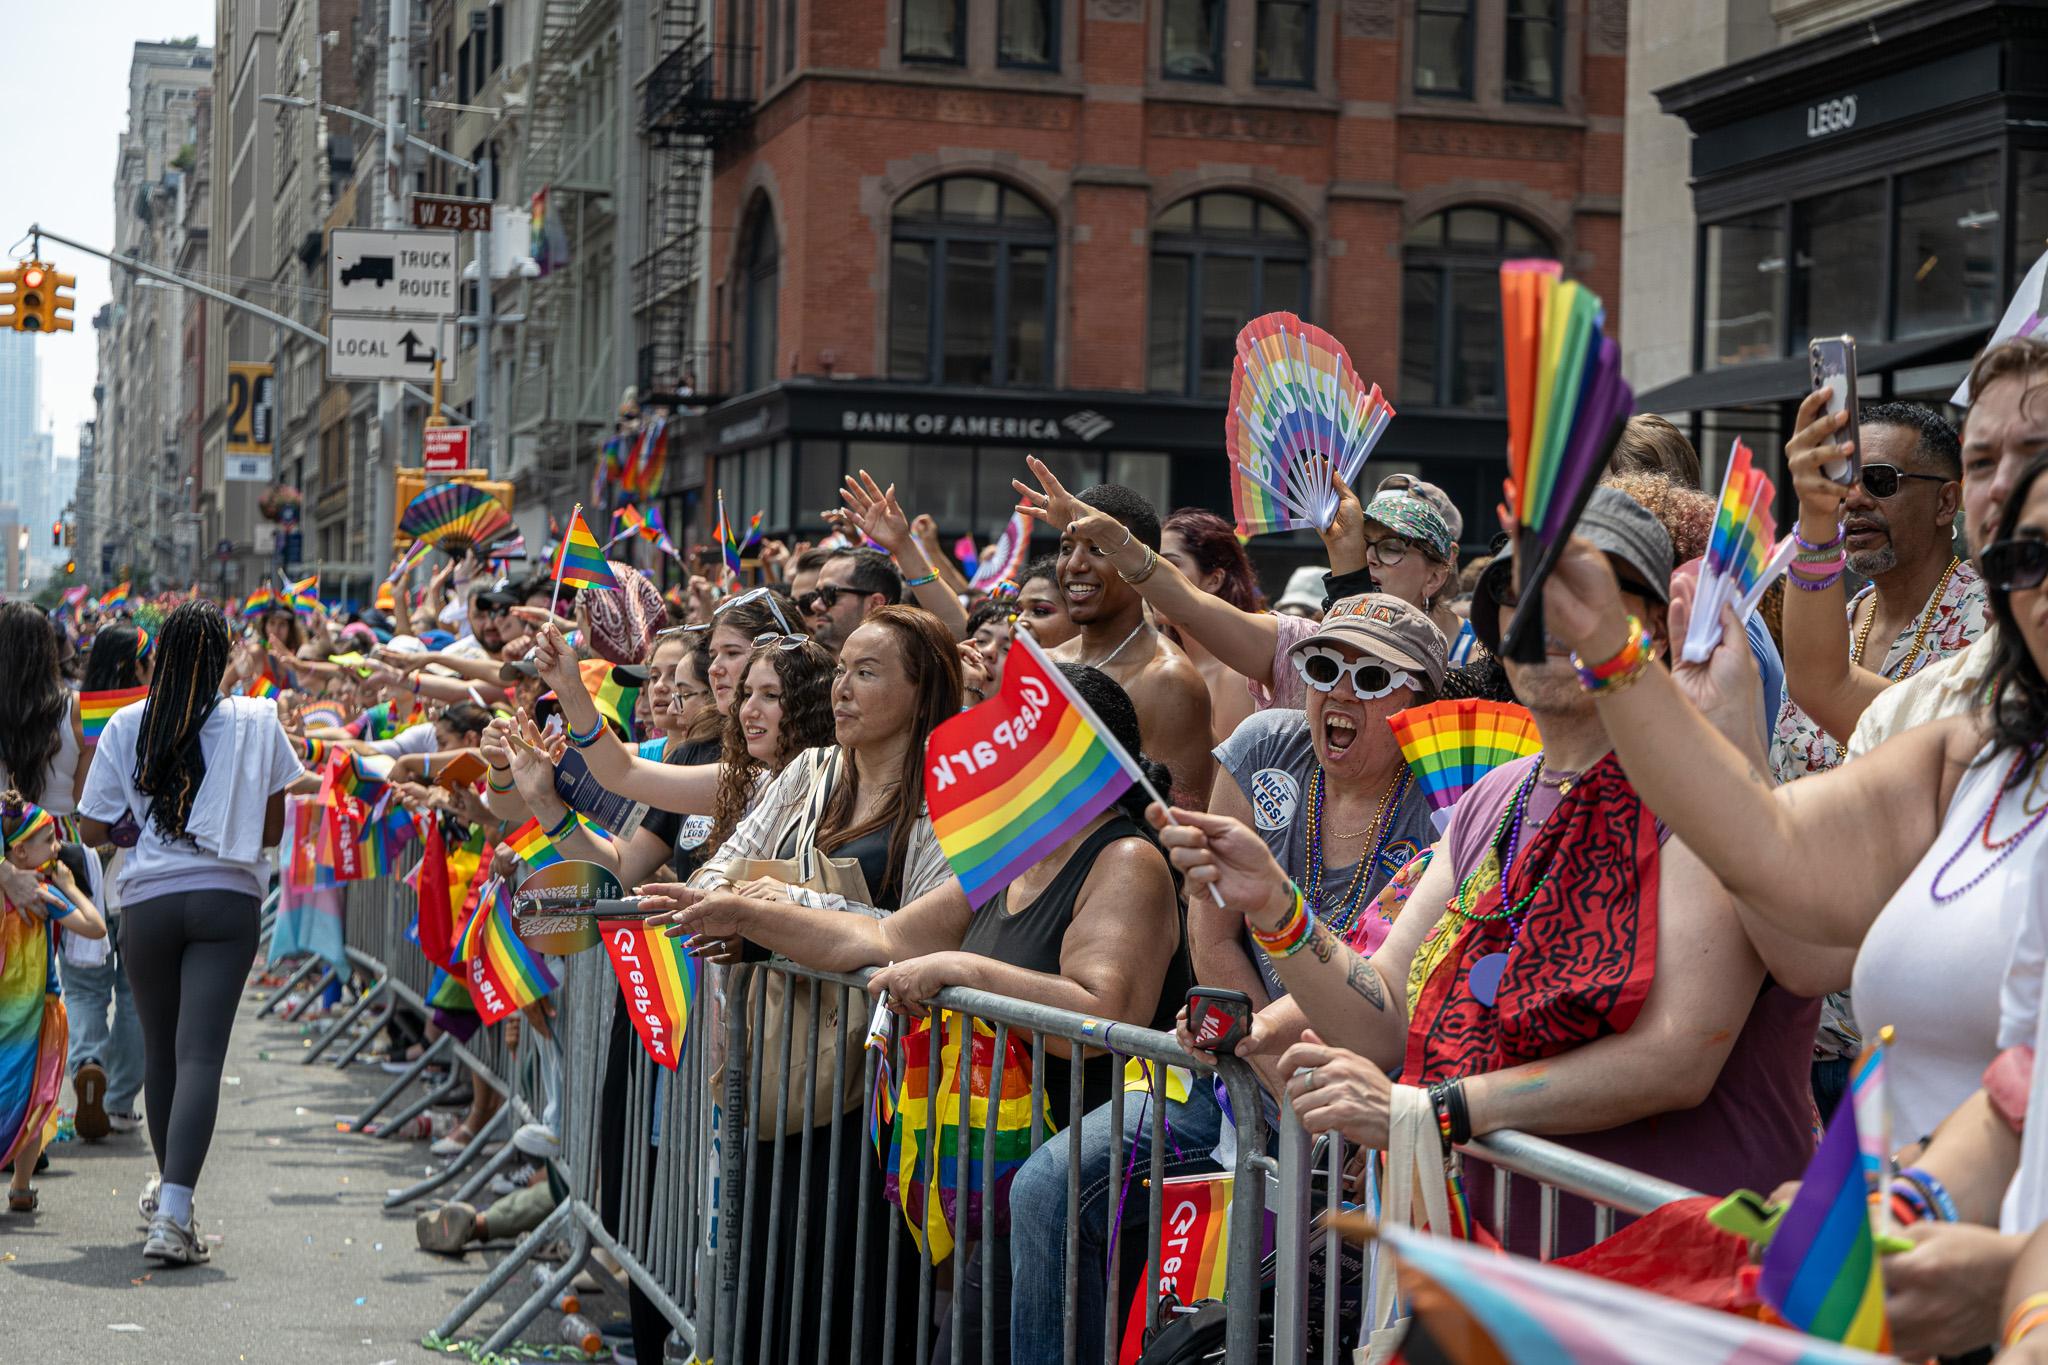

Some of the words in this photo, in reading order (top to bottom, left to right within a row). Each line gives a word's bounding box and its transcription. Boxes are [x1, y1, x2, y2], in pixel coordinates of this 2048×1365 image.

[1807, 96, 1857, 137] LEGO
[420, 203, 436, 225] W
[442, 205, 462, 227] 23
[468, 207, 487, 229] St
[400, 250, 451, 269] TRUCK
[399, 279, 451, 297] ROUTE
[336, 338, 389, 358] LOCAL
[842, 411, 911, 433] BANK
[914, 413, 947, 434] OF
[950, 416, 1061, 440] AMERICA
[1257, 772, 1289, 806] NICE
[1252, 784, 1286, 825] LEGS!
[684, 820, 705, 830] NICE
[727, 1069, 742, 1160] FRIEDRICHS
